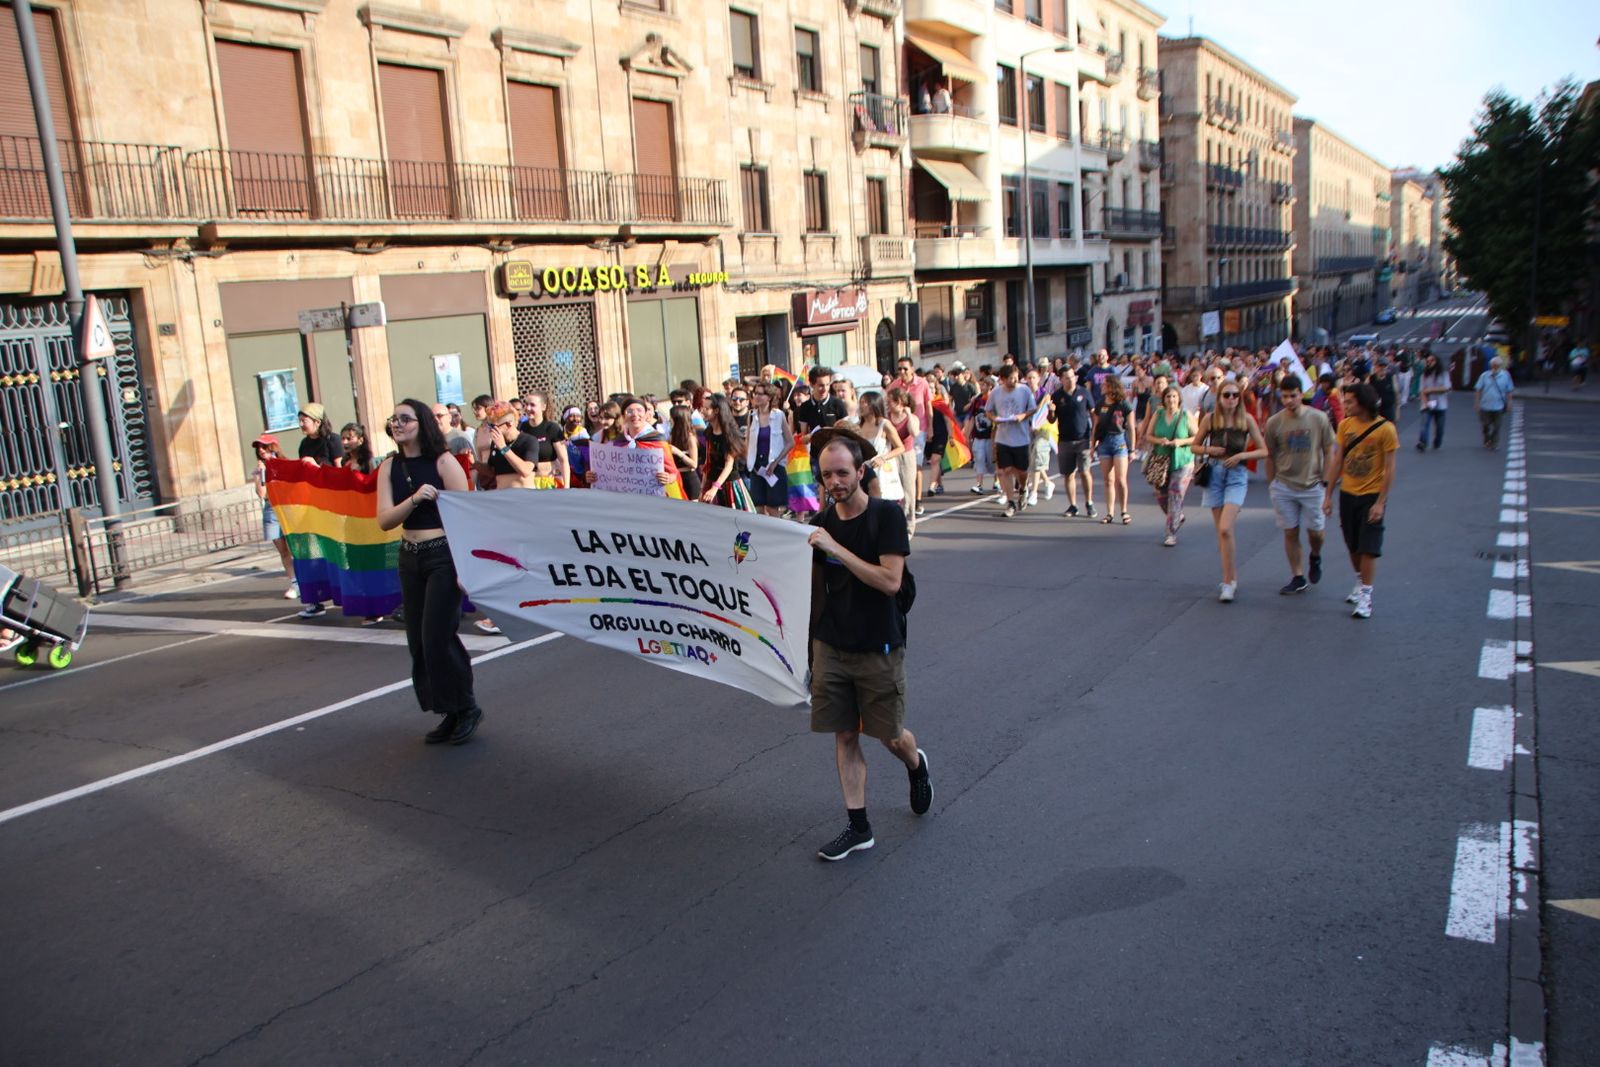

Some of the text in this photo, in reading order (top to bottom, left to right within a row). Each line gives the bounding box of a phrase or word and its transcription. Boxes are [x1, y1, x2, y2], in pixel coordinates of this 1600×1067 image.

[637, 263, 653, 289] S.
[658, 263, 676, 287] A.
[688, 271, 730, 285] SEGUROS
[611, 451, 624, 464] HE
[571, 529, 710, 567] LA PLUMA
[548, 563, 752, 617] LE DA EL TOQUE
[589, 613, 742, 656] ORGULLO CHARRO
